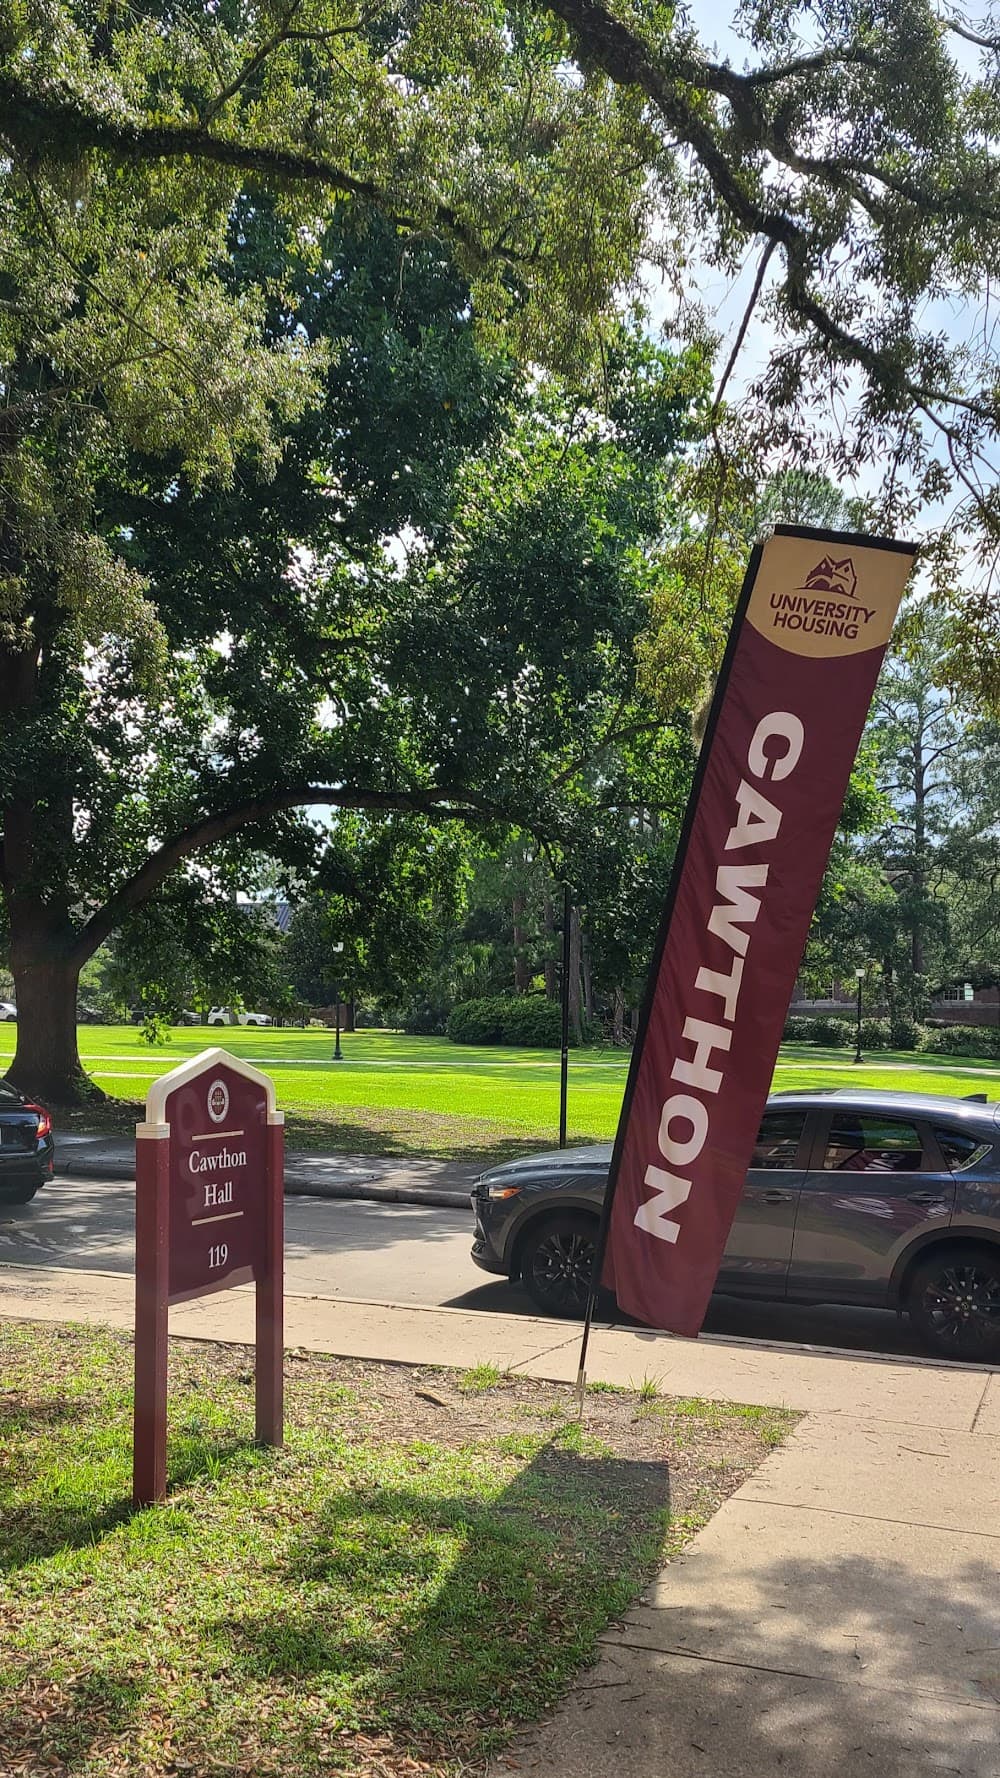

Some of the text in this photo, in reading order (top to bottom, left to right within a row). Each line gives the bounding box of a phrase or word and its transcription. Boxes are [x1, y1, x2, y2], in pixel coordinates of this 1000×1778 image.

[770, 593, 876, 624] UNIVERSITY
[773, 611, 860, 640] HOUSING
[633, 711, 805, 1245] CAWTHON
[189, 1148, 247, 1173] Cawthon
[204, 1181, 233, 1207] Hall
[208, 1243, 228, 1269] 119
